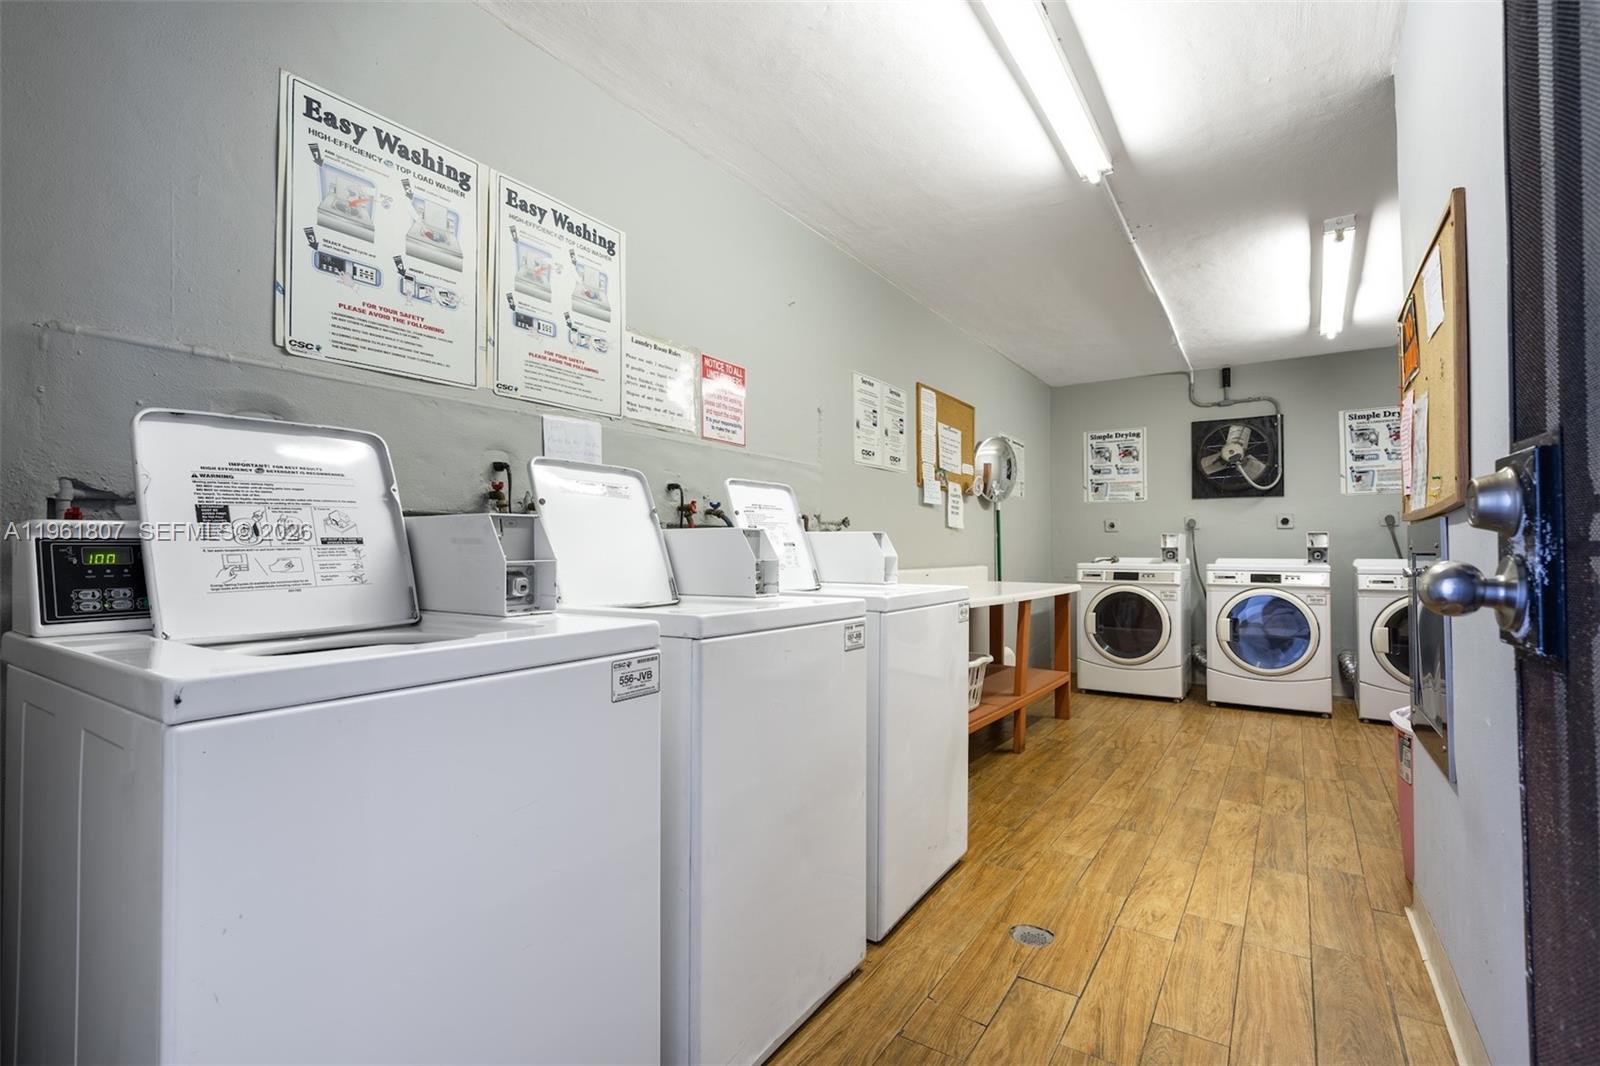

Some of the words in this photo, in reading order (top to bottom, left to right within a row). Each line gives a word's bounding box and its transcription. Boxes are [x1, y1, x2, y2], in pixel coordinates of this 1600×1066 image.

[303, 95, 367, 145] Easy
[373, 126, 472, 192] Washing
[308, 128, 383, 164] HIGH-EFFICIENCY
[396, 164, 412, 176] TOP
[413, 172, 434, 186] LOAD
[435, 180, 466, 199] WASHER
[505, 187, 547, 225] Easy
[551, 208, 616, 257] Washing
[338, 303, 367, 314] PLEASE
[368, 311, 391, 321] AVOID
[392, 317, 406, 325] THE
[407, 320, 445, 334] FOLLOWING
[361, 302, 377, 310] FOR
[378, 306, 398, 316] YOUR
[400, 311, 425, 322] SAFETY
[289, 339, 314, 351] CSC
[631, 336, 652, 350] Laundry
[653, 343, 668, 354] Room
[668, 348, 682, 357] Rules
[703, 357, 725, 372] NOTICE
[725, 364, 733, 374] TO
[733, 367, 744, 378] ALL
[496, 383, 513, 392] CSC
[1348, 411, 1381, 421] Simple
[1090, 433, 1113, 441] Simple
[1114, 431, 1141, 439] Drying
[861, 449, 872, 457] CSC
[89, 553, 116, 565] 100
[619, 670, 653, 685] 556-JVB
